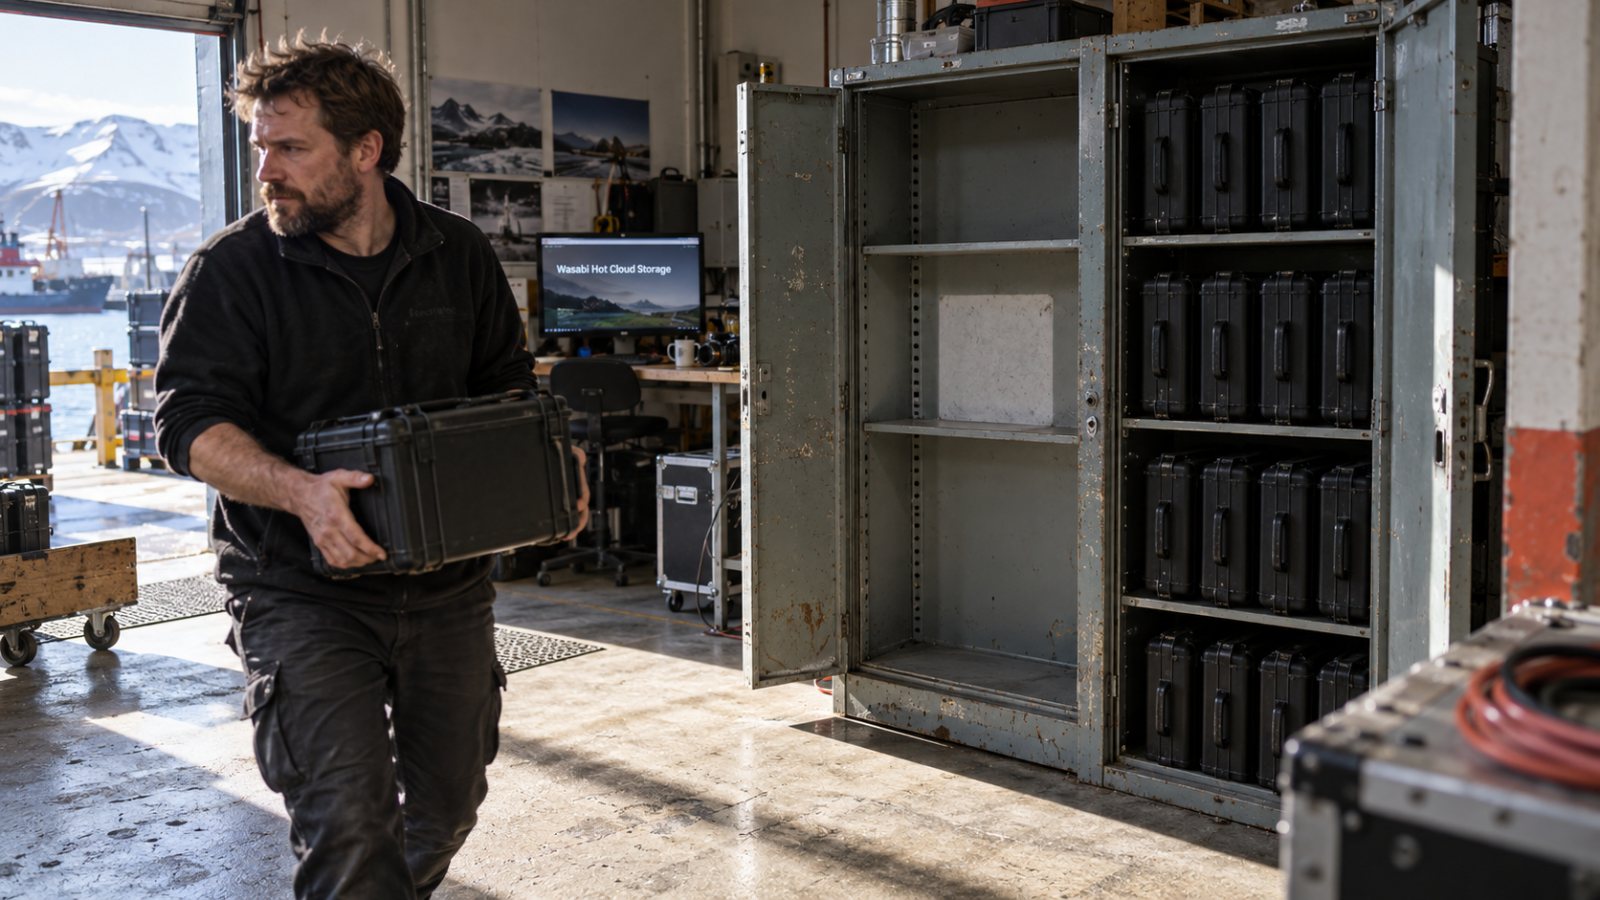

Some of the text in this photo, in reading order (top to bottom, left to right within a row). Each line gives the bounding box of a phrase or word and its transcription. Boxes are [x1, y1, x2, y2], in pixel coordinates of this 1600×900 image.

[556, 264, 672, 276] Wasabi Hot Cloud Storage
